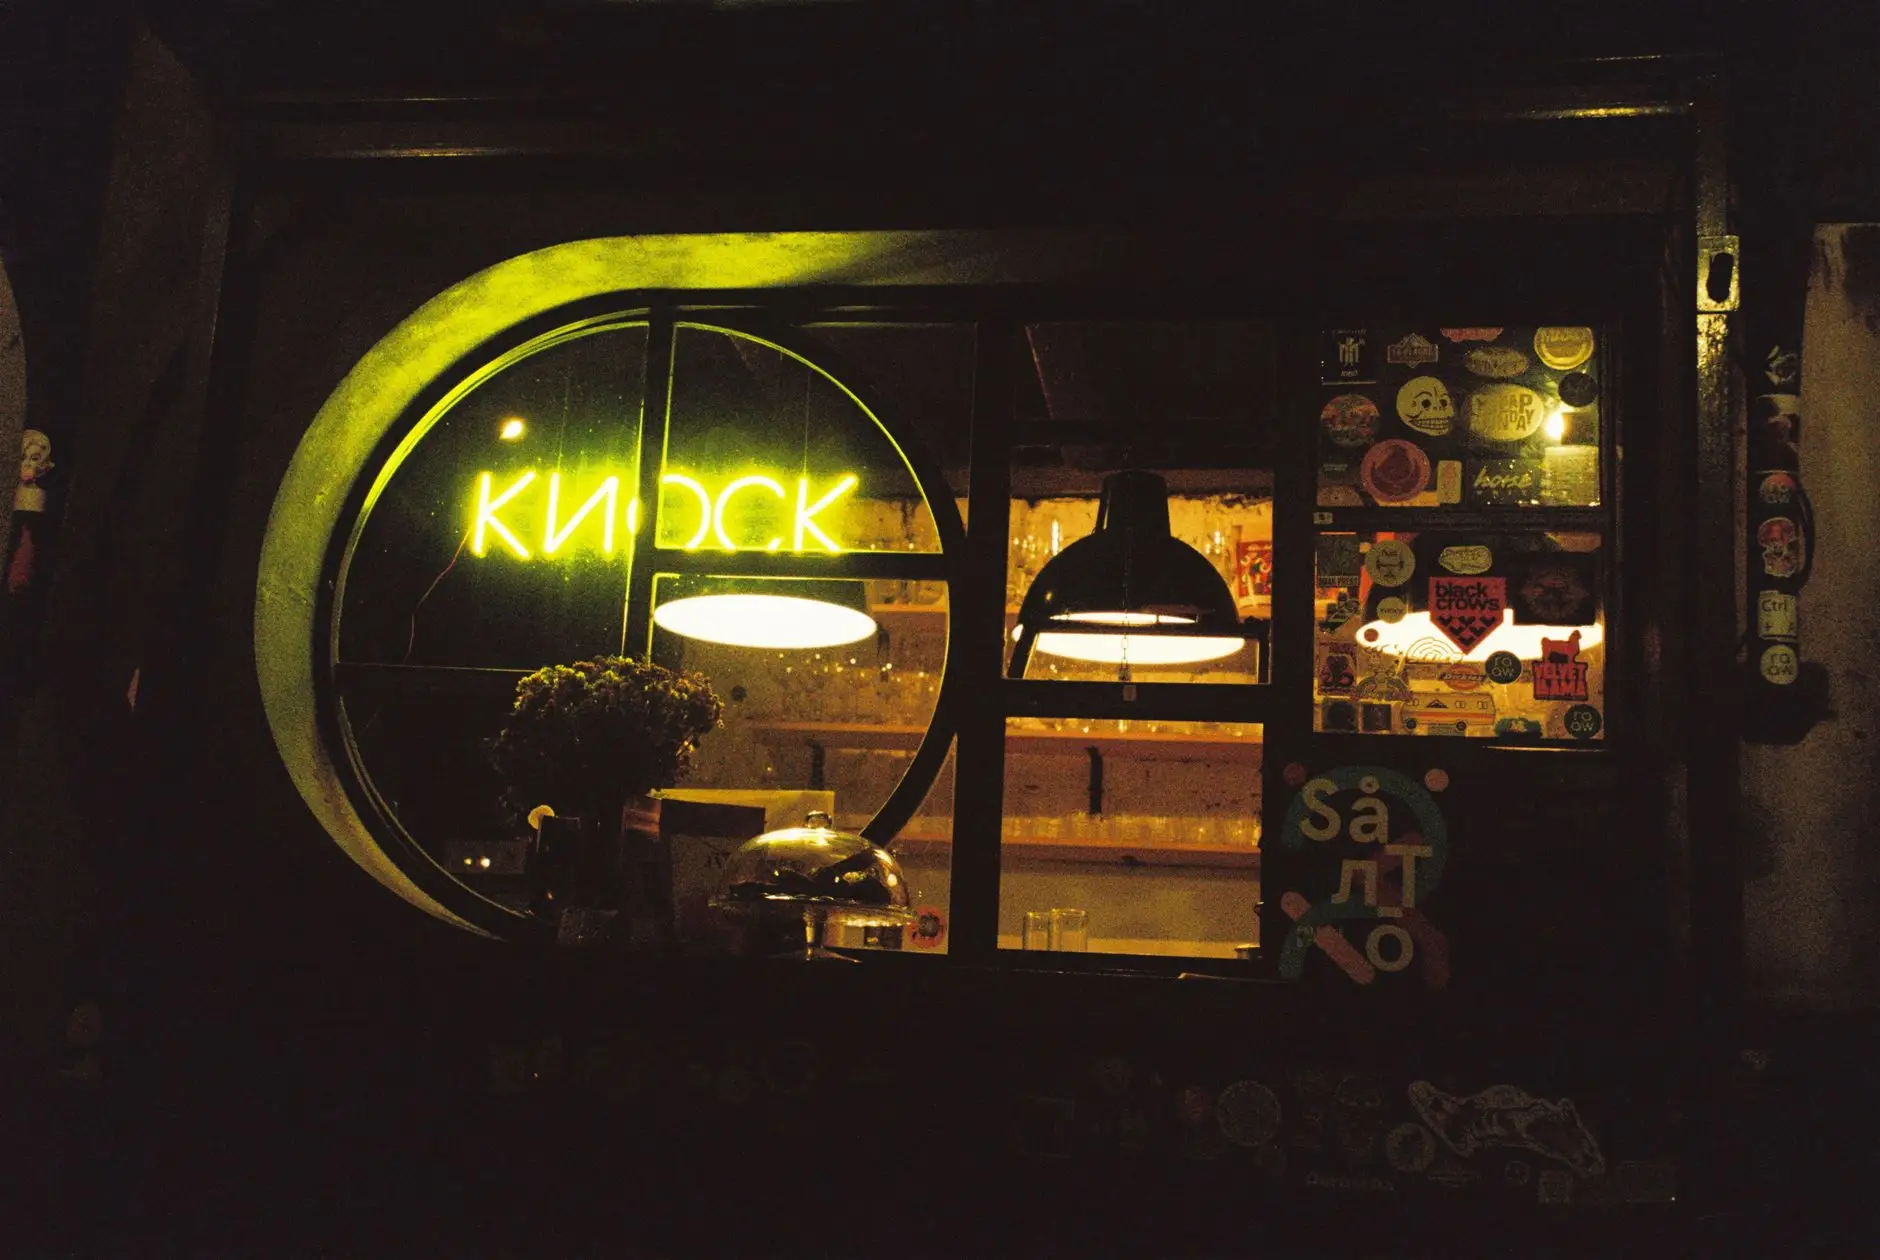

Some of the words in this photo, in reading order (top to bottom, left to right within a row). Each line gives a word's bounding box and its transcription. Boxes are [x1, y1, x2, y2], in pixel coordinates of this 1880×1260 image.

[468, 471, 860, 558] КИОСК
[1434, 580, 1487, 598] black
[1435, 598, 1500, 611] crows
[1762, 600, 1788, 612] Ctrl
